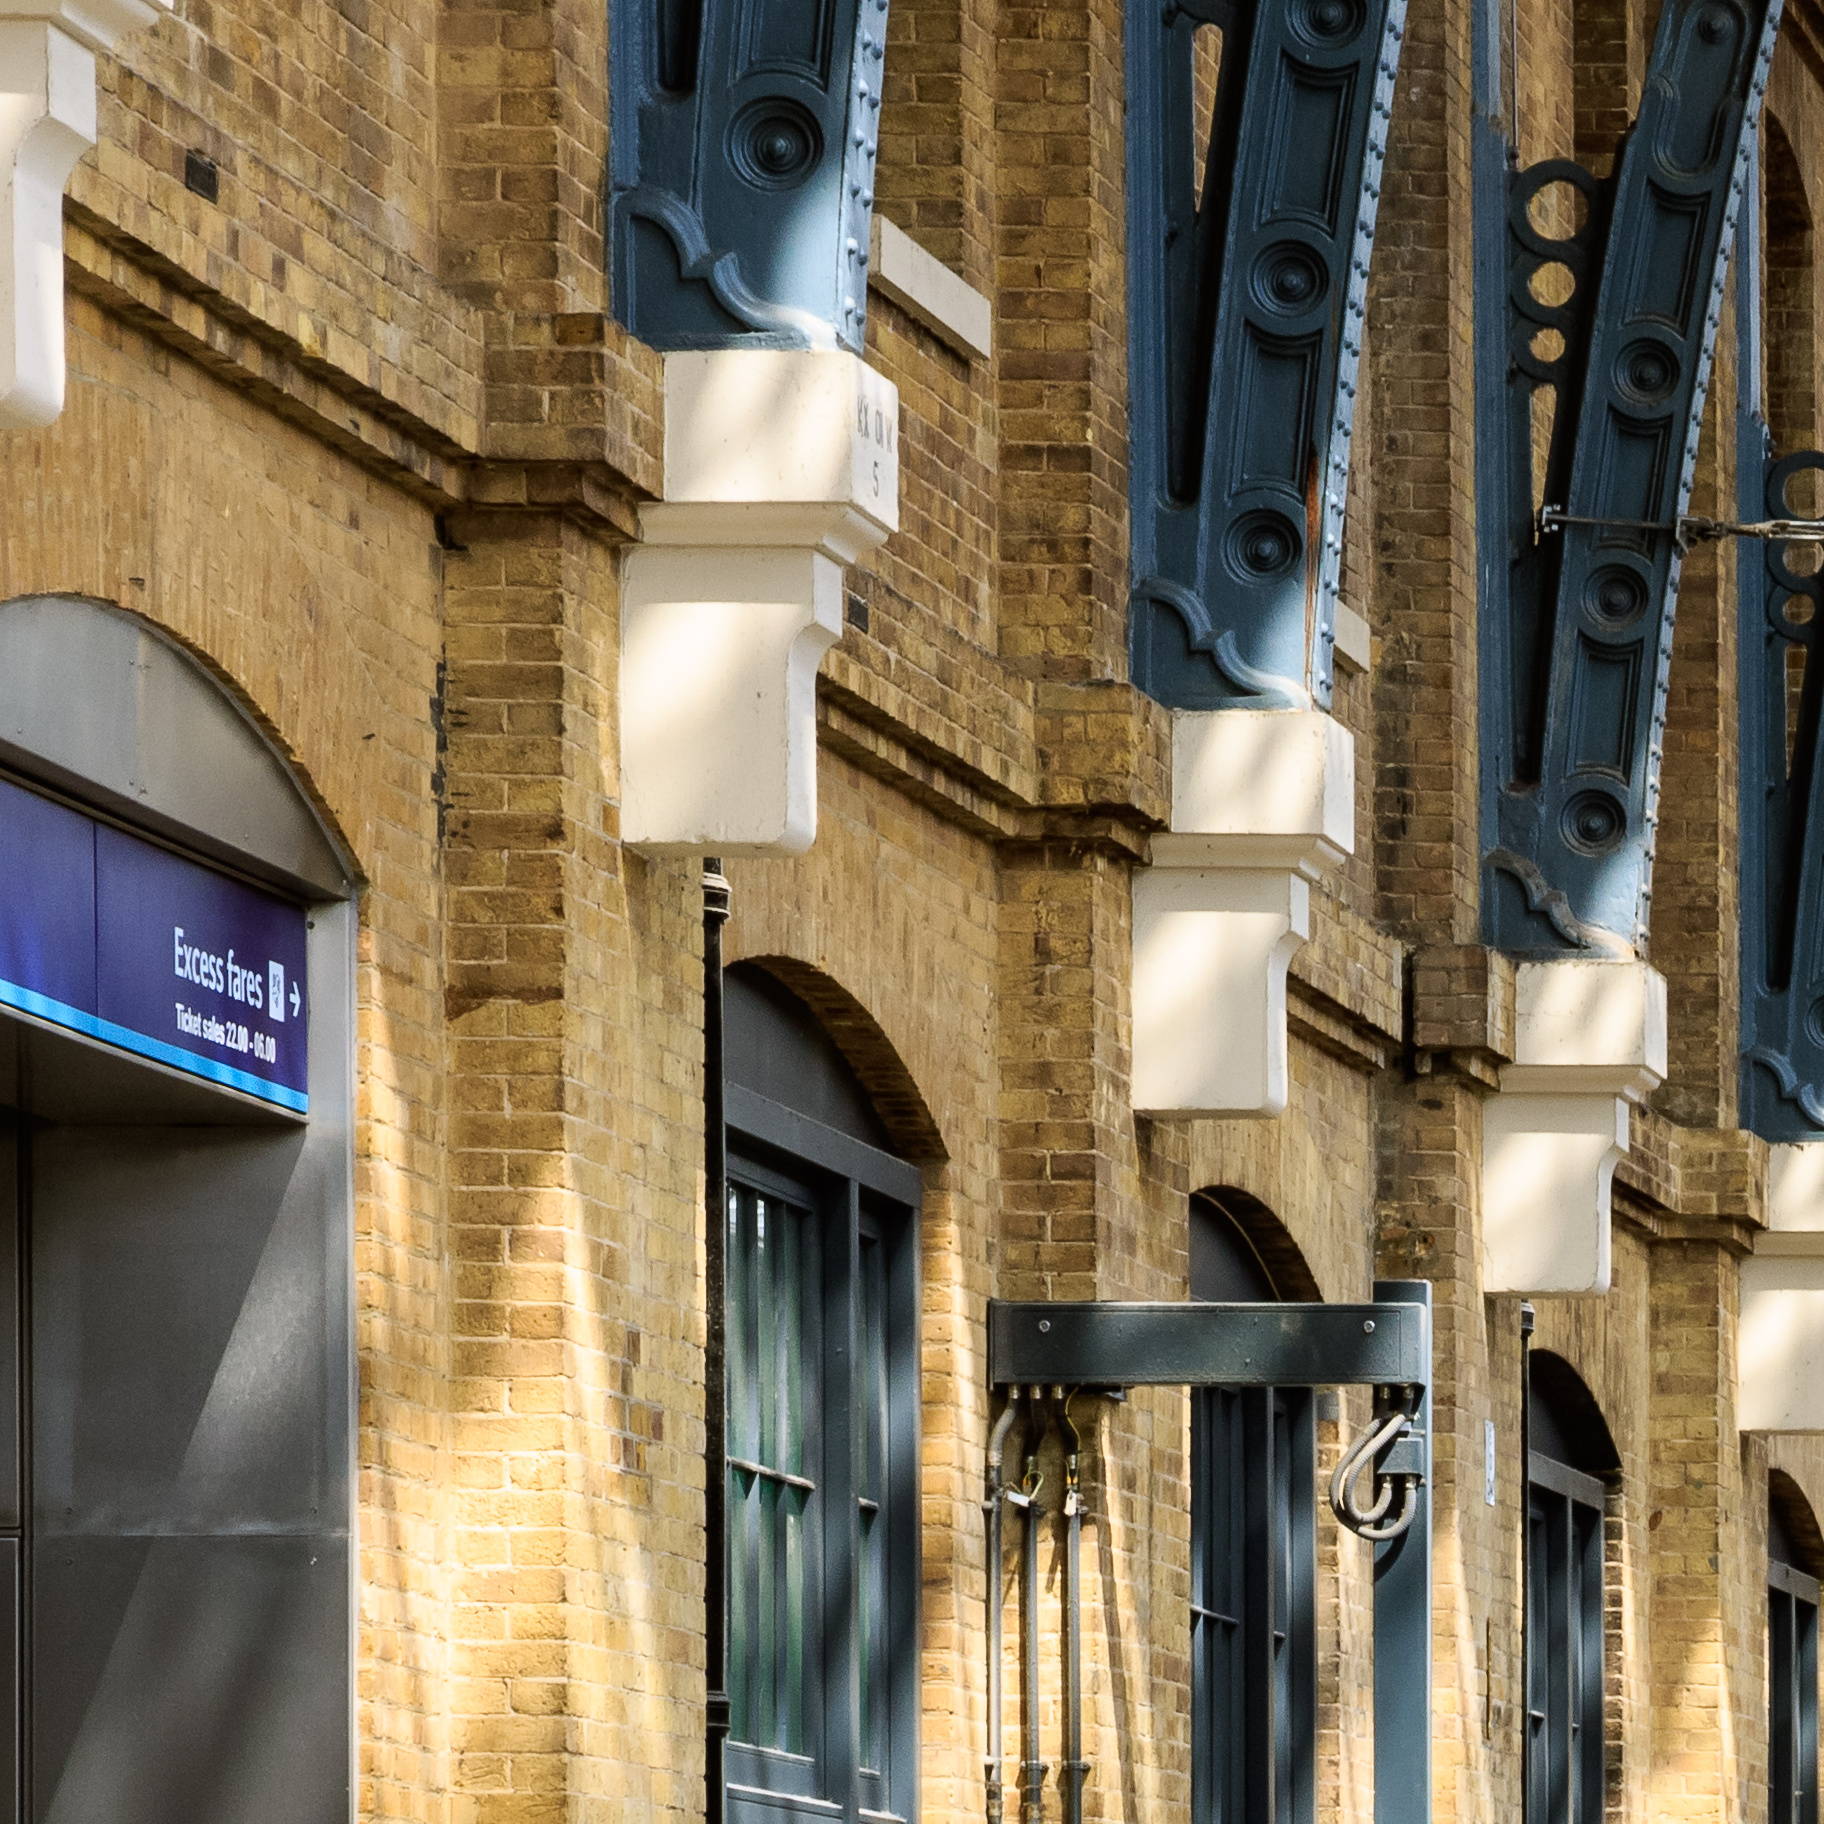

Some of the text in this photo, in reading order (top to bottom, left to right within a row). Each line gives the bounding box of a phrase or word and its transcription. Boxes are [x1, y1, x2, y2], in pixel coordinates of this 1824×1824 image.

[174, 926, 263, 1009] Excess fares
[175, 1003, 202, 1037] Ticket
[203, 1015, 225, 1045] sales
[254, 1031, 276, 1064] 06.00
